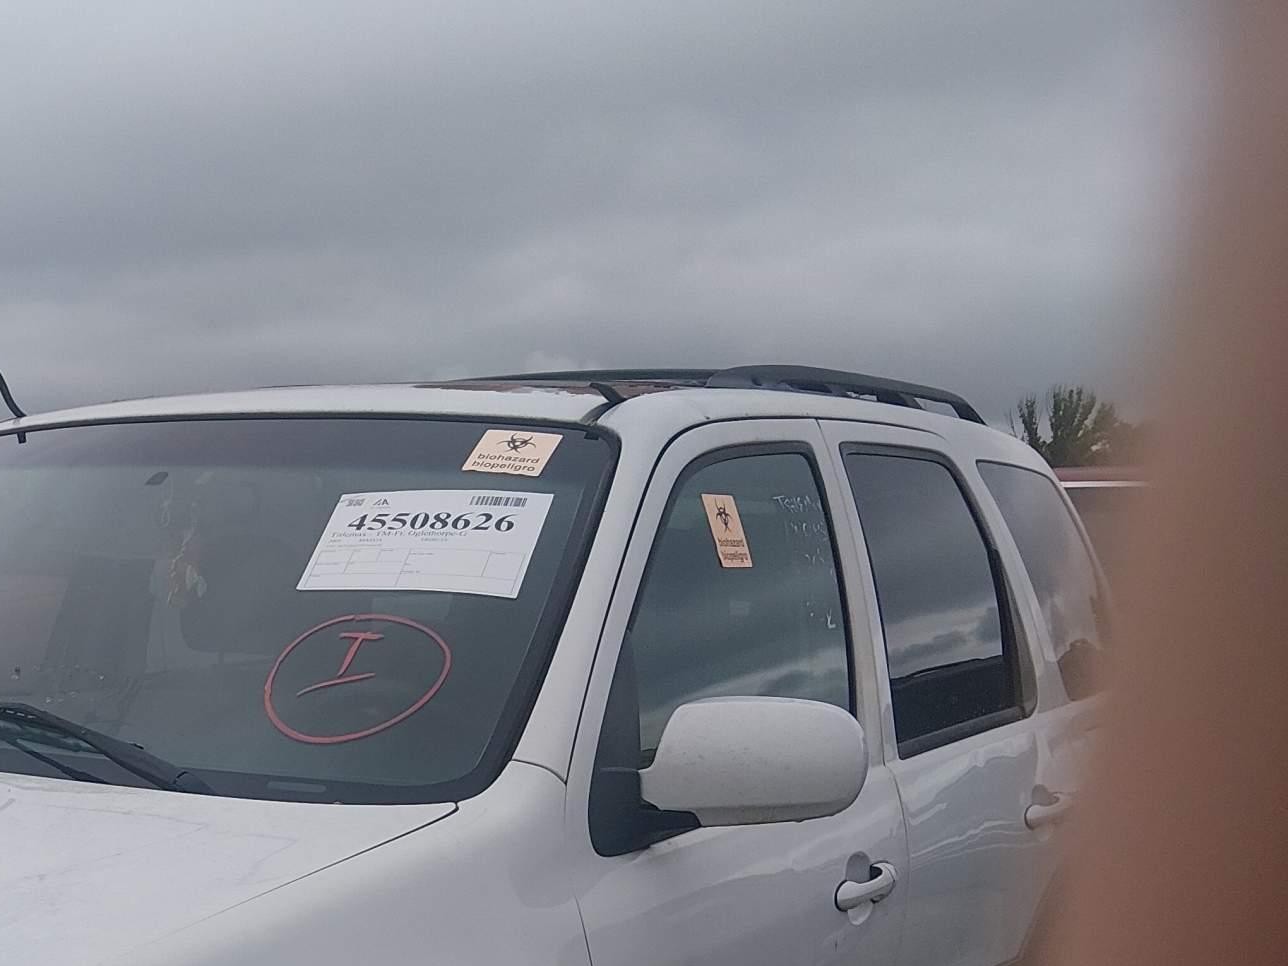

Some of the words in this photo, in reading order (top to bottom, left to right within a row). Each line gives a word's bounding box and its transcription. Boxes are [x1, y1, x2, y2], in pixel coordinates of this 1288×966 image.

[476, 453, 541, 464] biohazard
[472, 460, 536, 472] biopeligro
[347, 512, 519, 532] 45508626
